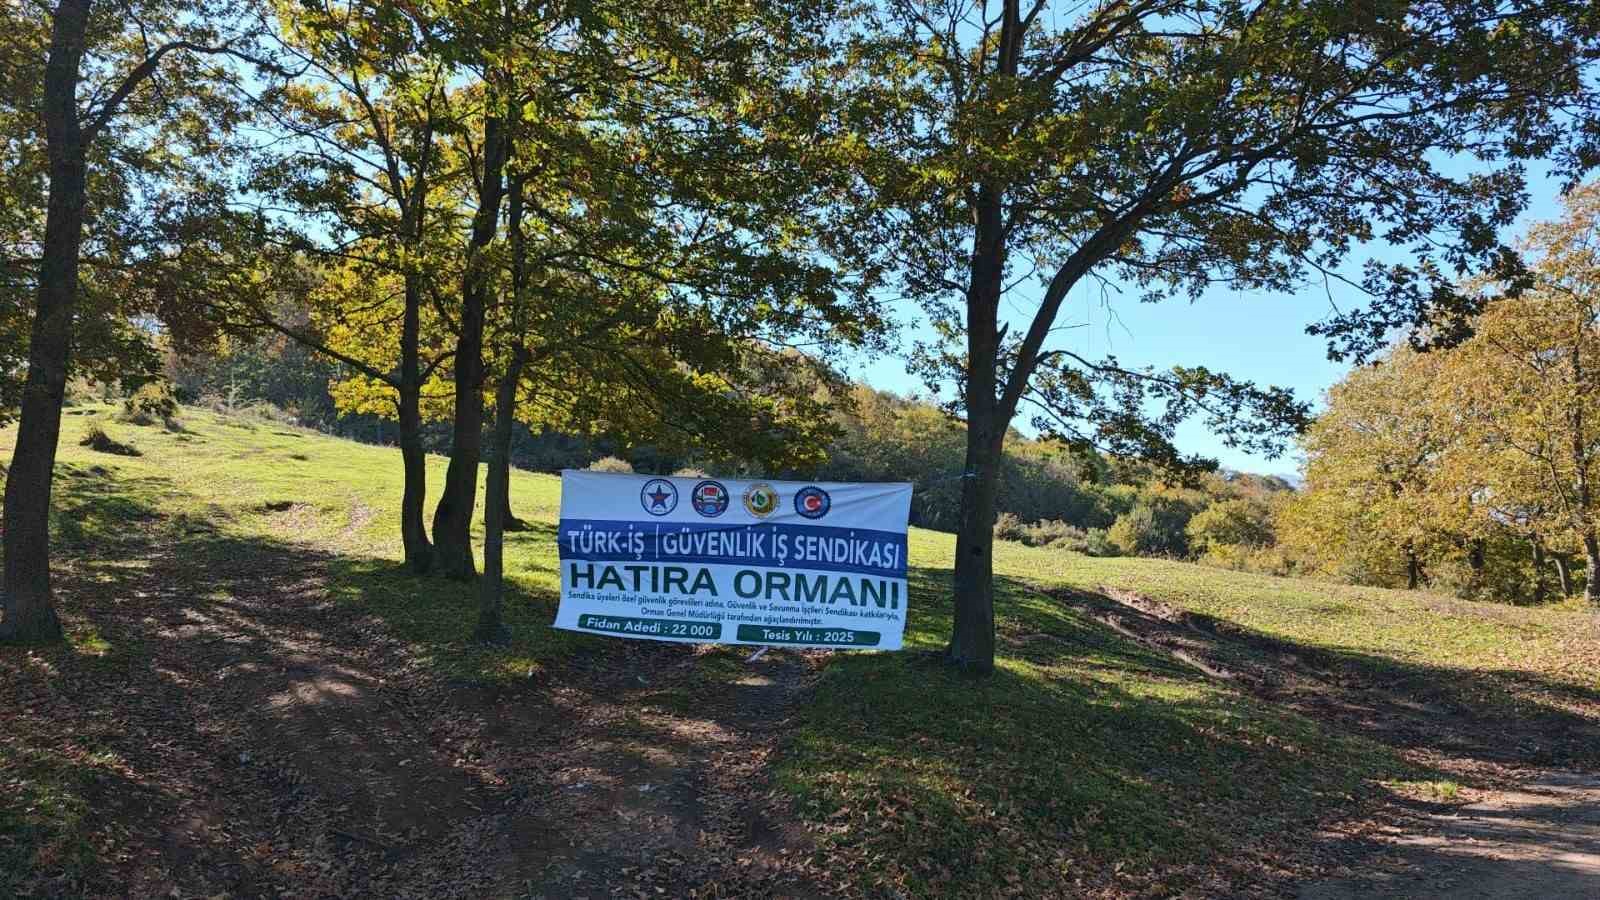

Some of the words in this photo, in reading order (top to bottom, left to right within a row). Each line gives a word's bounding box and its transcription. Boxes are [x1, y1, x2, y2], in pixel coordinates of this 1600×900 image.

[568, 524, 645, 560] TÜRK-İŞ
[663, 526, 766, 557] GÜVENLİK
[772, 526, 788, 566] İŞ
[794, 531, 900, 569] SENDİKASI
[571, 563, 719, 597] HATIRA
[734, 569, 899, 609] ORMANI
[568, 591, 595, 600] Sendika
[597, 592, 620, 603] üyeleri
[622, 593, 636, 602] özel
[638, 595, 666, 606] güvenlik
[727, 600, 757, 609] Güvenlik
[759, 603, 767, 611] ve
[769, 603, 800, 612] Savunma
[825, 607, 858, 616] Sendikası
[641, 607, 664, 616] Orman
[666, 608, 686, 617] Genel
[587, 617, 620, 630] Fidan
[624, 620, 660, 633] Adedi
[672, 623, 687, 635] 22
[690, 625, 713, 636] 000
[763, 629, 791, 640] Tesis
[795, 630, 813, 641] Yılı
[823, 631, 854, 642] 2025
